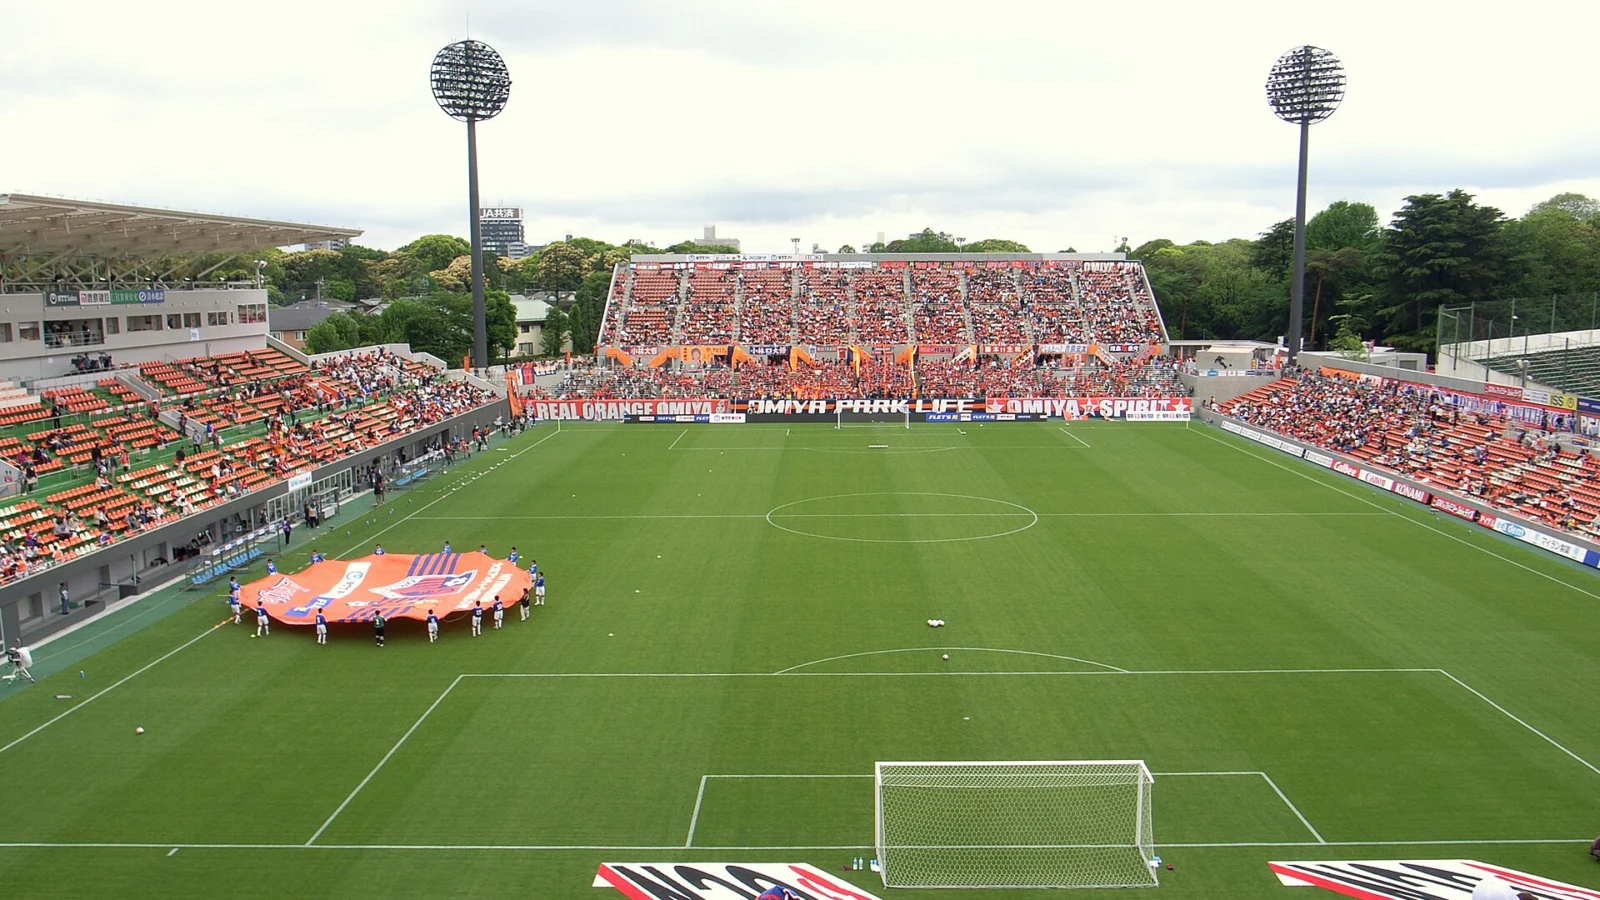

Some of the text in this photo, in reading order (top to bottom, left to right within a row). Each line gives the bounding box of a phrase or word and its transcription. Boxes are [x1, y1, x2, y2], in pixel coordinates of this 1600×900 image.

[480, 208, 514, 218] JA共済
[536, 401, 711, 420] REAL ORANGE OMIYA
[749, 399, 975, 414] OMIYA PARK LIFE
[1006, 400, 1080, 417] OMIYA
[1099, 399, 1171, 417] SPIRIT
[1333, 460, 1358, 477] Calbee
[1365, 472, 1387, 487] Canon
[1395, 482, 1425, 501] KONAMI
